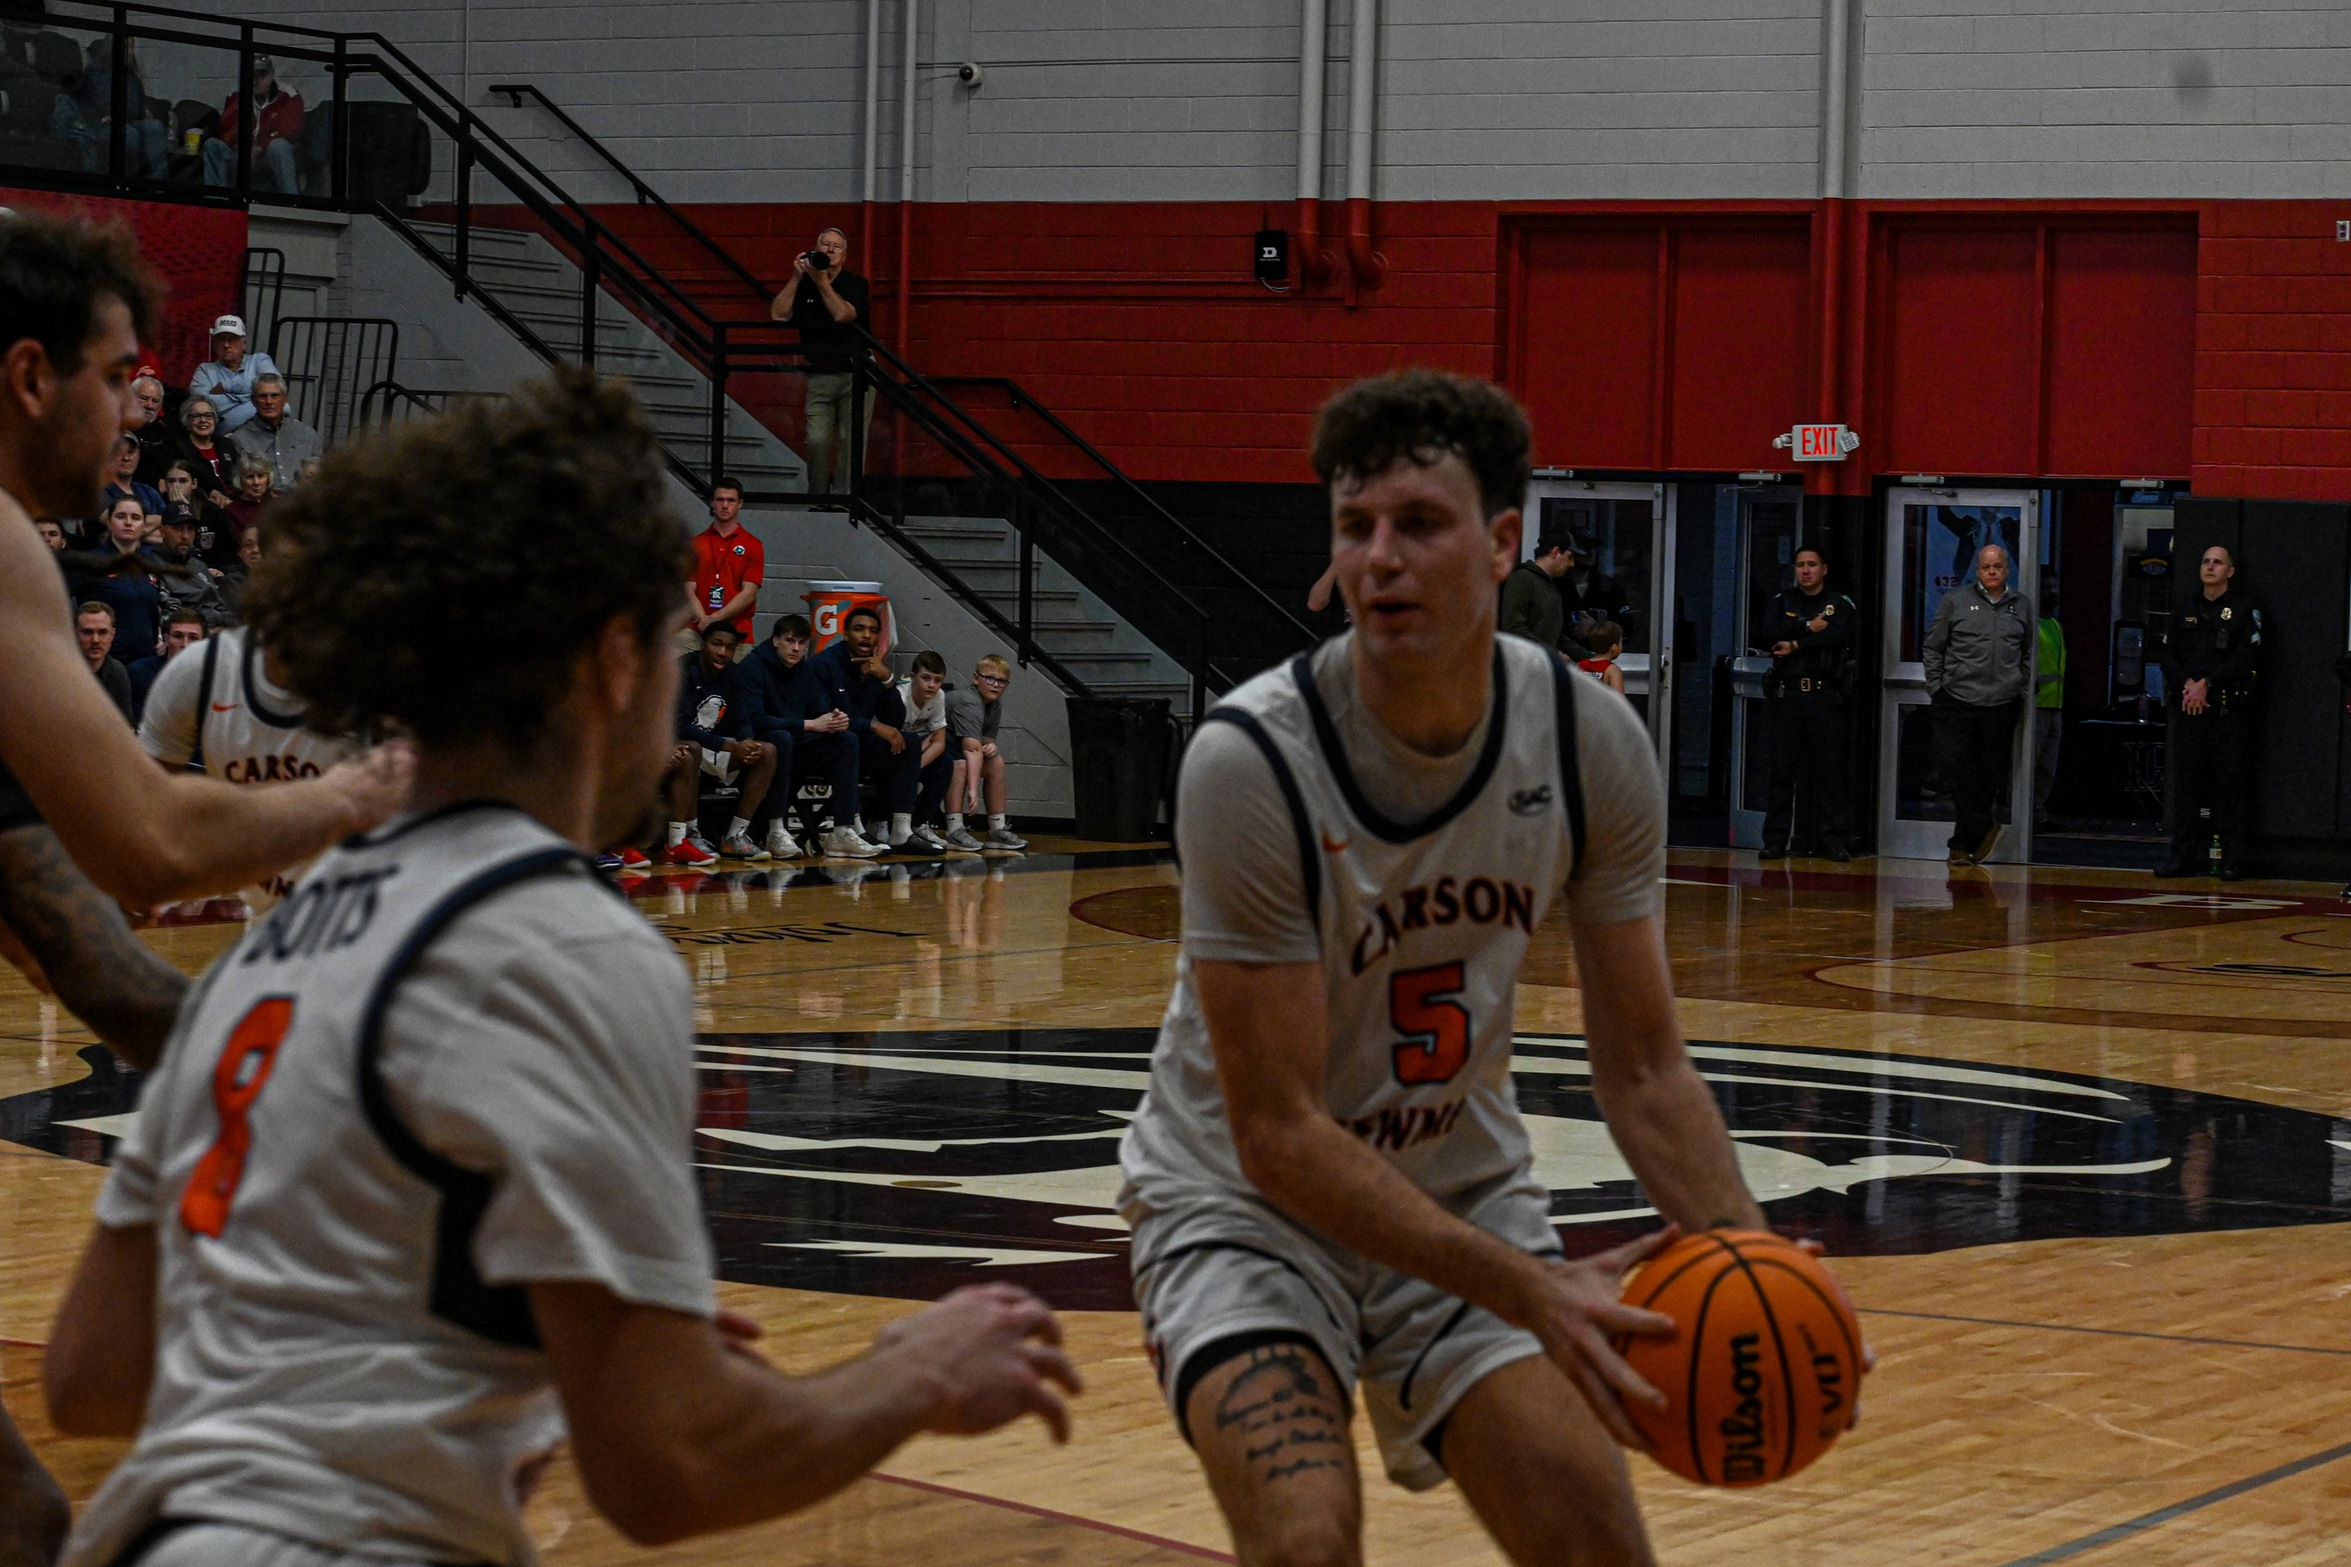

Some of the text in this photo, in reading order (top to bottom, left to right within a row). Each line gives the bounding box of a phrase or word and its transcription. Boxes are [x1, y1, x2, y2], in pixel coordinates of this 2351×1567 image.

[1802, 427, 1838, 455] EXIT
[815, 604, 838, 635] G
[225, 754, 322, 784] CARSO
[1353, 876, 1533, 976] CARSON
[1390, 960, 1471, 1087] 5
[1720, 1332, 1764, 1482] Wilson
